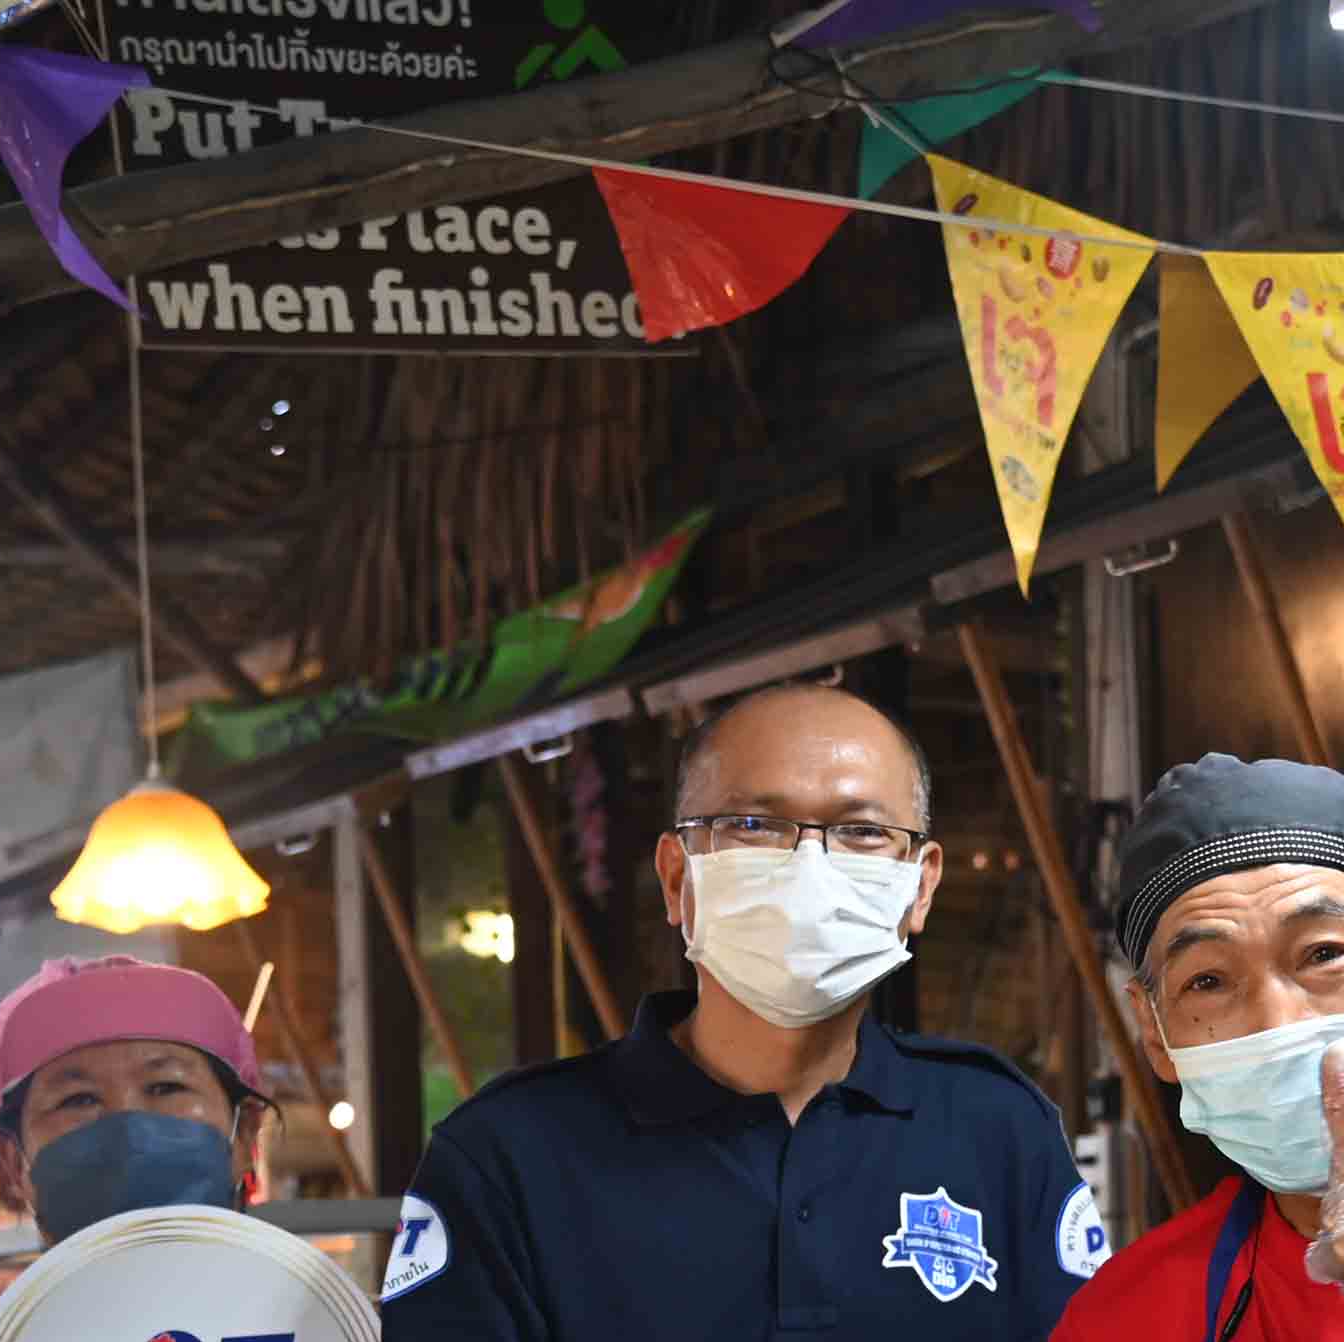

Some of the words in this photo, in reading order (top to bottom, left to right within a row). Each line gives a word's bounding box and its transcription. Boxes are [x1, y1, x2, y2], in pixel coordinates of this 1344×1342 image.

[120, 29, 479, 80] กรุณานำไปทิ้งขยะด้วยค่ะ
[126, 89, 261, 160] Put
[149, 263, 354, 332] when
